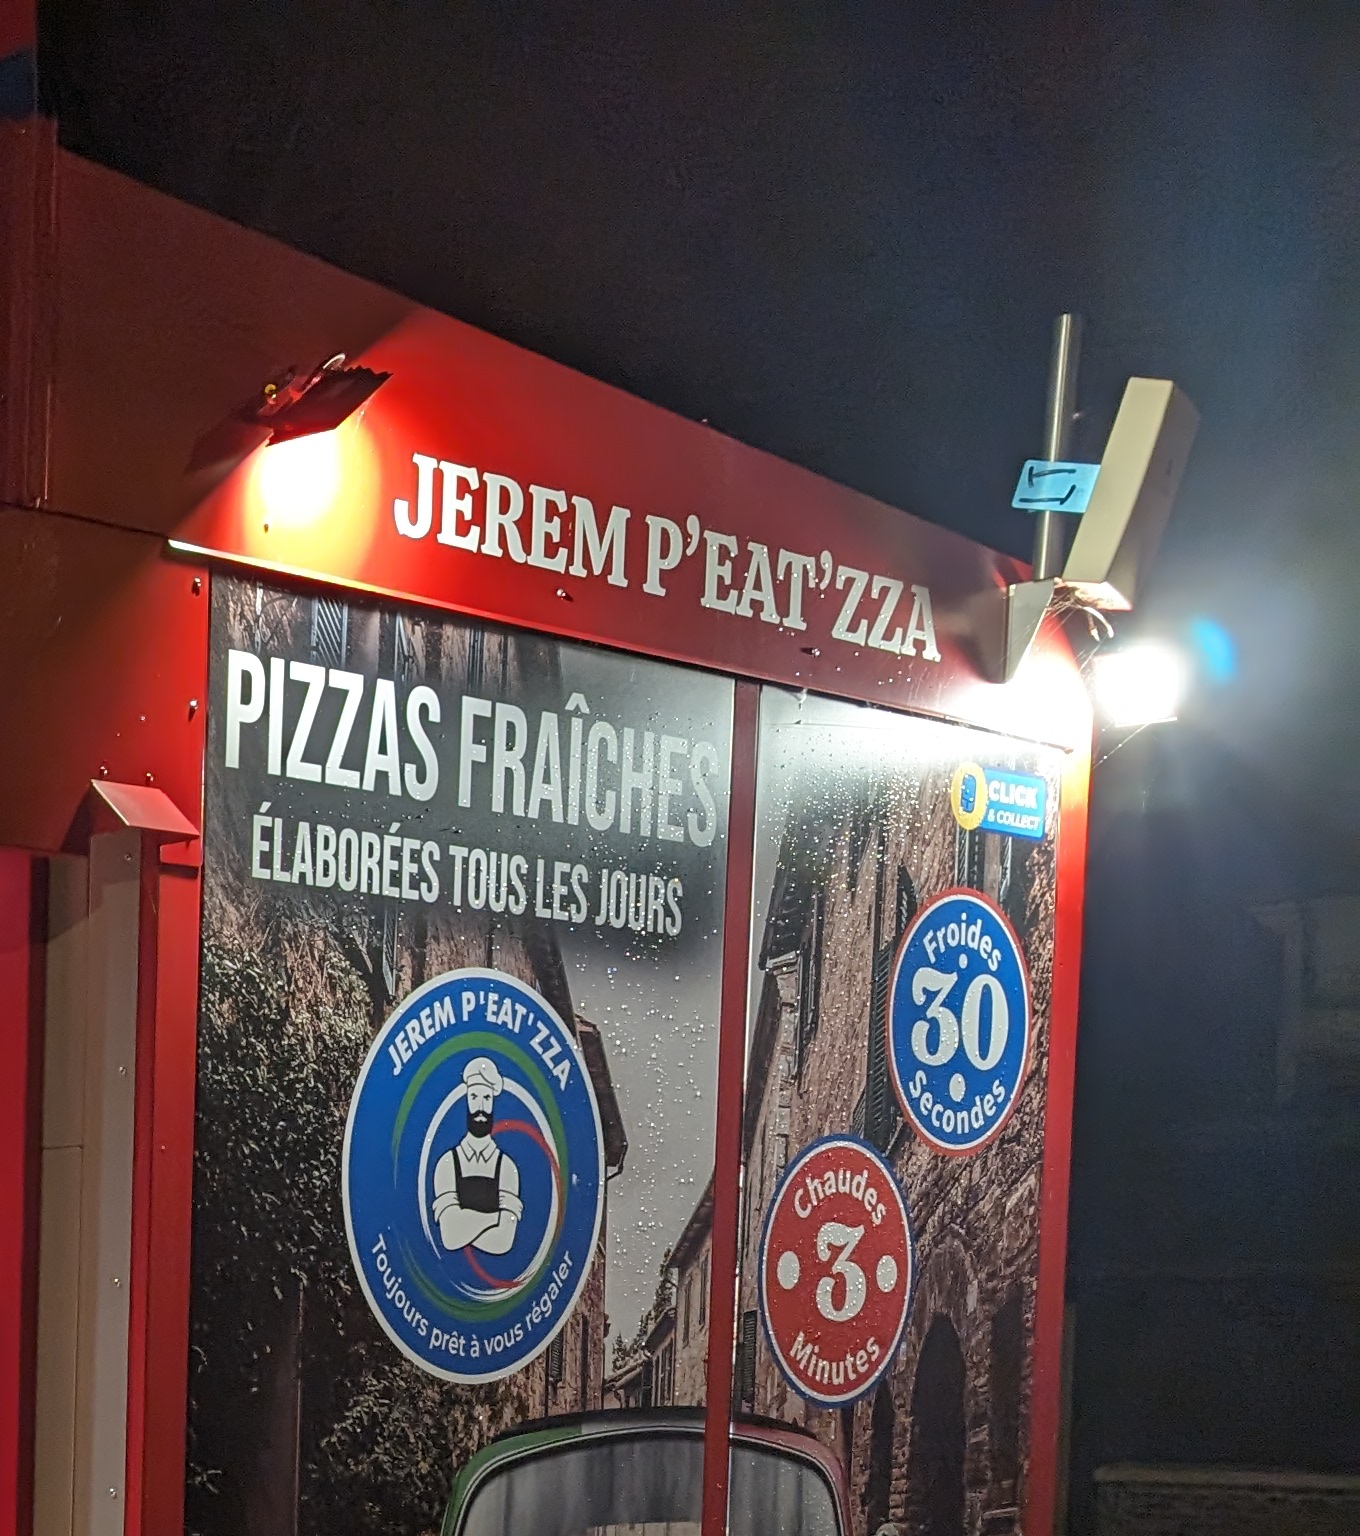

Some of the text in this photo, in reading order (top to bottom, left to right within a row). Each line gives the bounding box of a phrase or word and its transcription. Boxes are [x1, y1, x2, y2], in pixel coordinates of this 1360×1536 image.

[393, 452, 632, 580] JEREM
[224, 648, 721, 850] PIZZAS FRAÎCHES
[989, 780, 1038, 809] CLICK
[997, 810, 1041, 831] COLLECT
[252, 802, 682, 938] ÉLABORÉES TOUS LES JOURS
[923, 912, 1002, 972] Froides
[387, 995, 456, 1076] JEREM
[910, 967, 1010, 1073] 30
[908, 1069, 1006, 1136] Secondes
[793, 1167, 887, 1225] Chaudes
[371, 1233, 575, 1358] Toujours prêt à vous régaler
[815, 1221, 867, 1324] 3
[790, 1329, 881, 1386] Minutes
